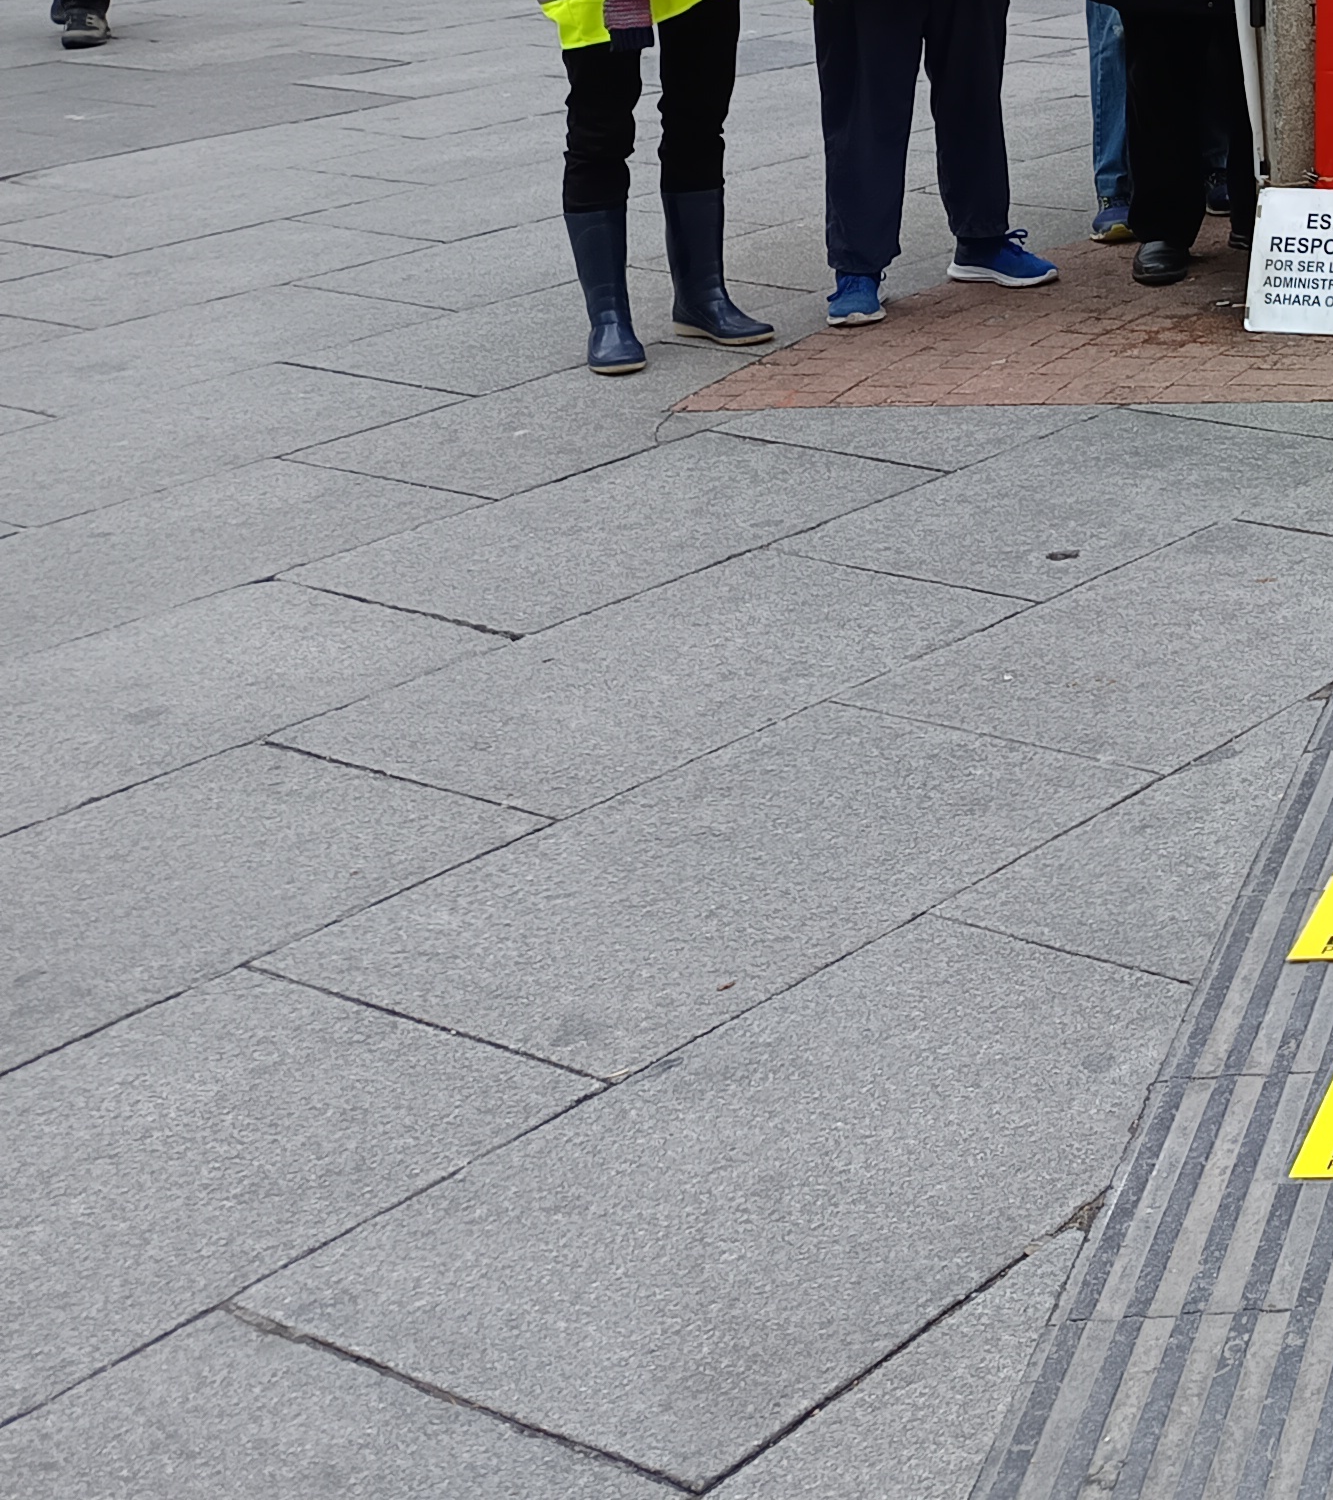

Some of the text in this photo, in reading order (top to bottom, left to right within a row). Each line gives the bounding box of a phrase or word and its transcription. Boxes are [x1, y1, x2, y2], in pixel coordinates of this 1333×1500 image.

[1264, 259, 1293, 272] POR
[1296, 260, 1325, 273] SER
[1264, 293, 1320, 307] SAHARA
